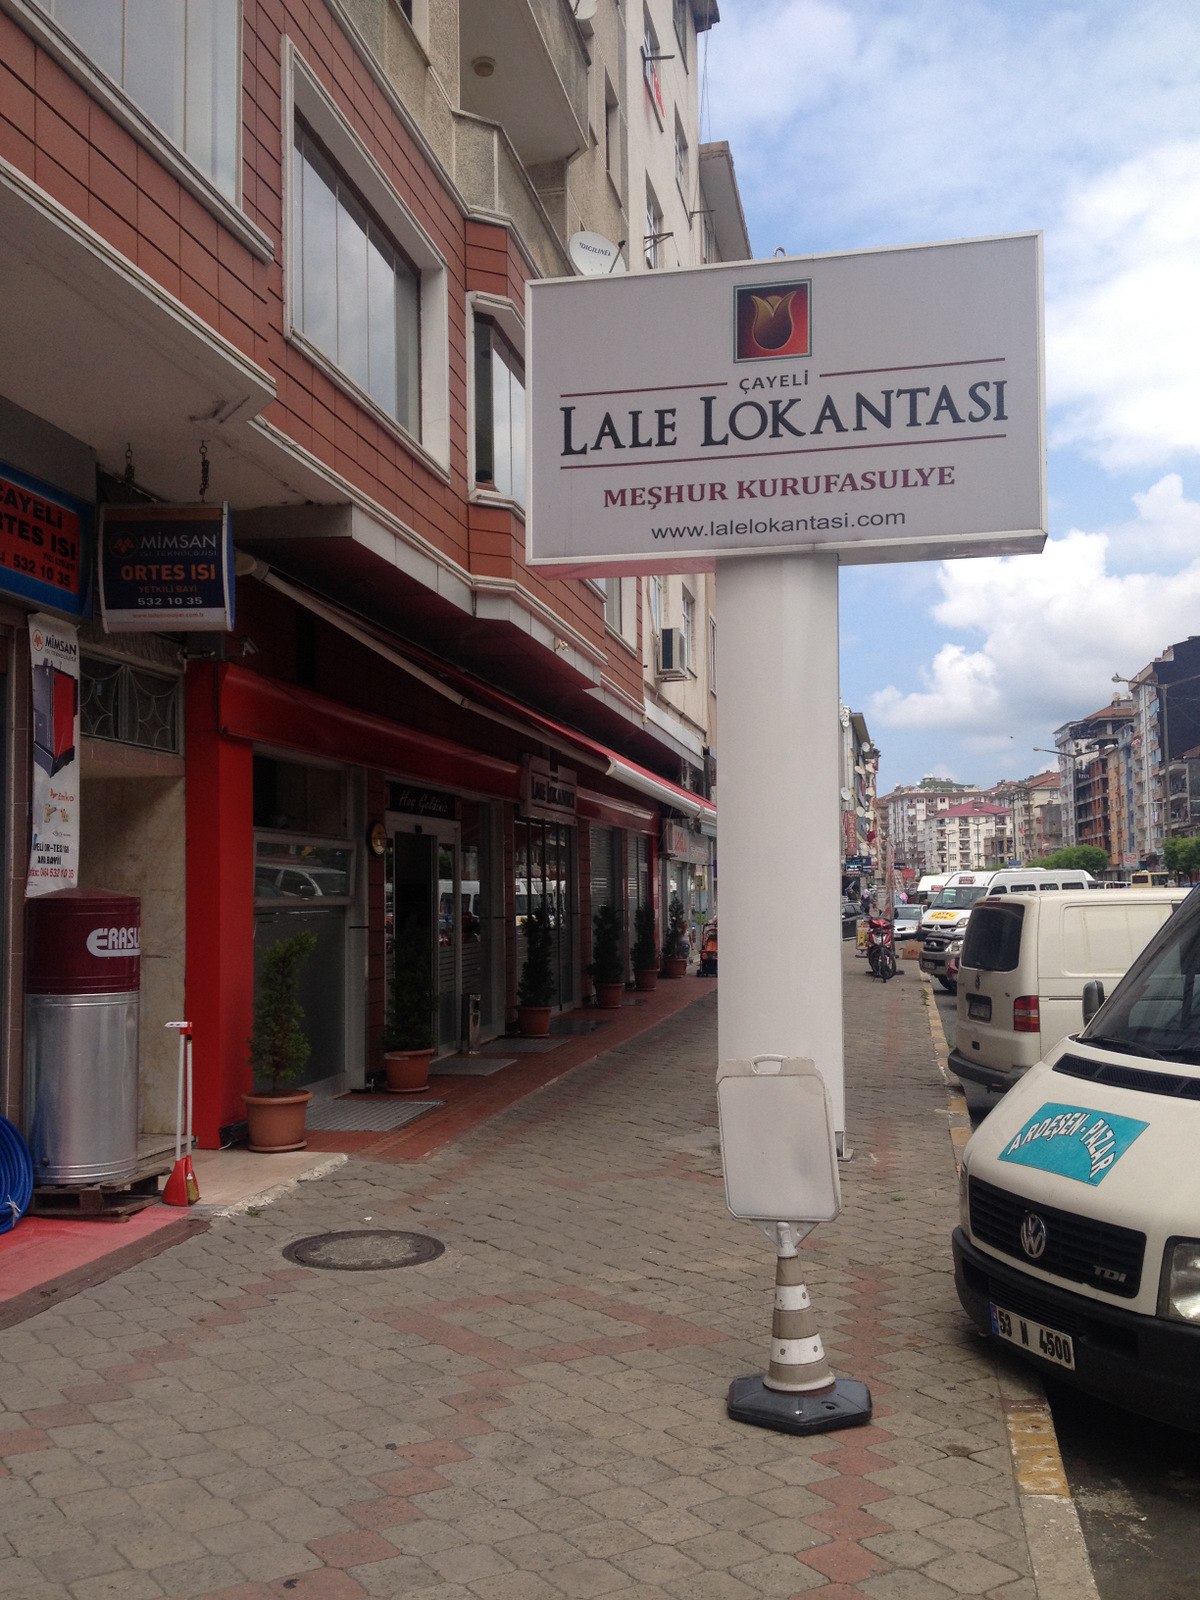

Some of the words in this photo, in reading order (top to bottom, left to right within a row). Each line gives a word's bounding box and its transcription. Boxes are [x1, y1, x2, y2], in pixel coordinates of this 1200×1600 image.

[738, 369, 809, 395] ÇAYELİ
[559, 405, 678, 457] LALE
[700, 379, 1009, 447] LOKANTASI
[603, 481, 729, 510] MEŞHUR
[736, 465, 956, 501] KURUFASULYE
[651, 511, 907, 541] www.lalelokantasi.com
[51, 533, 76, 561] ISI
[140, 531, 217, 549] MİMSAN
[13, 553, 36, 575] 532
[40, 565, 54, 581] 10
[57, 574, 71, 588] 35
[120, 564, 186, 581] ORTES
[190, 563, 216, 581] ISI
[137, 597, 163, 606] 532
[167, 597, 183, 605] 10
[186, 596, 203, 605] 35
[45, 635, 77, 656] MİMSAN
[1092, 1264, 1128, 1284] TDI
[998, 1310, 1012, 1337] 53
[1039, 1328, 1071, 1364] 4500
